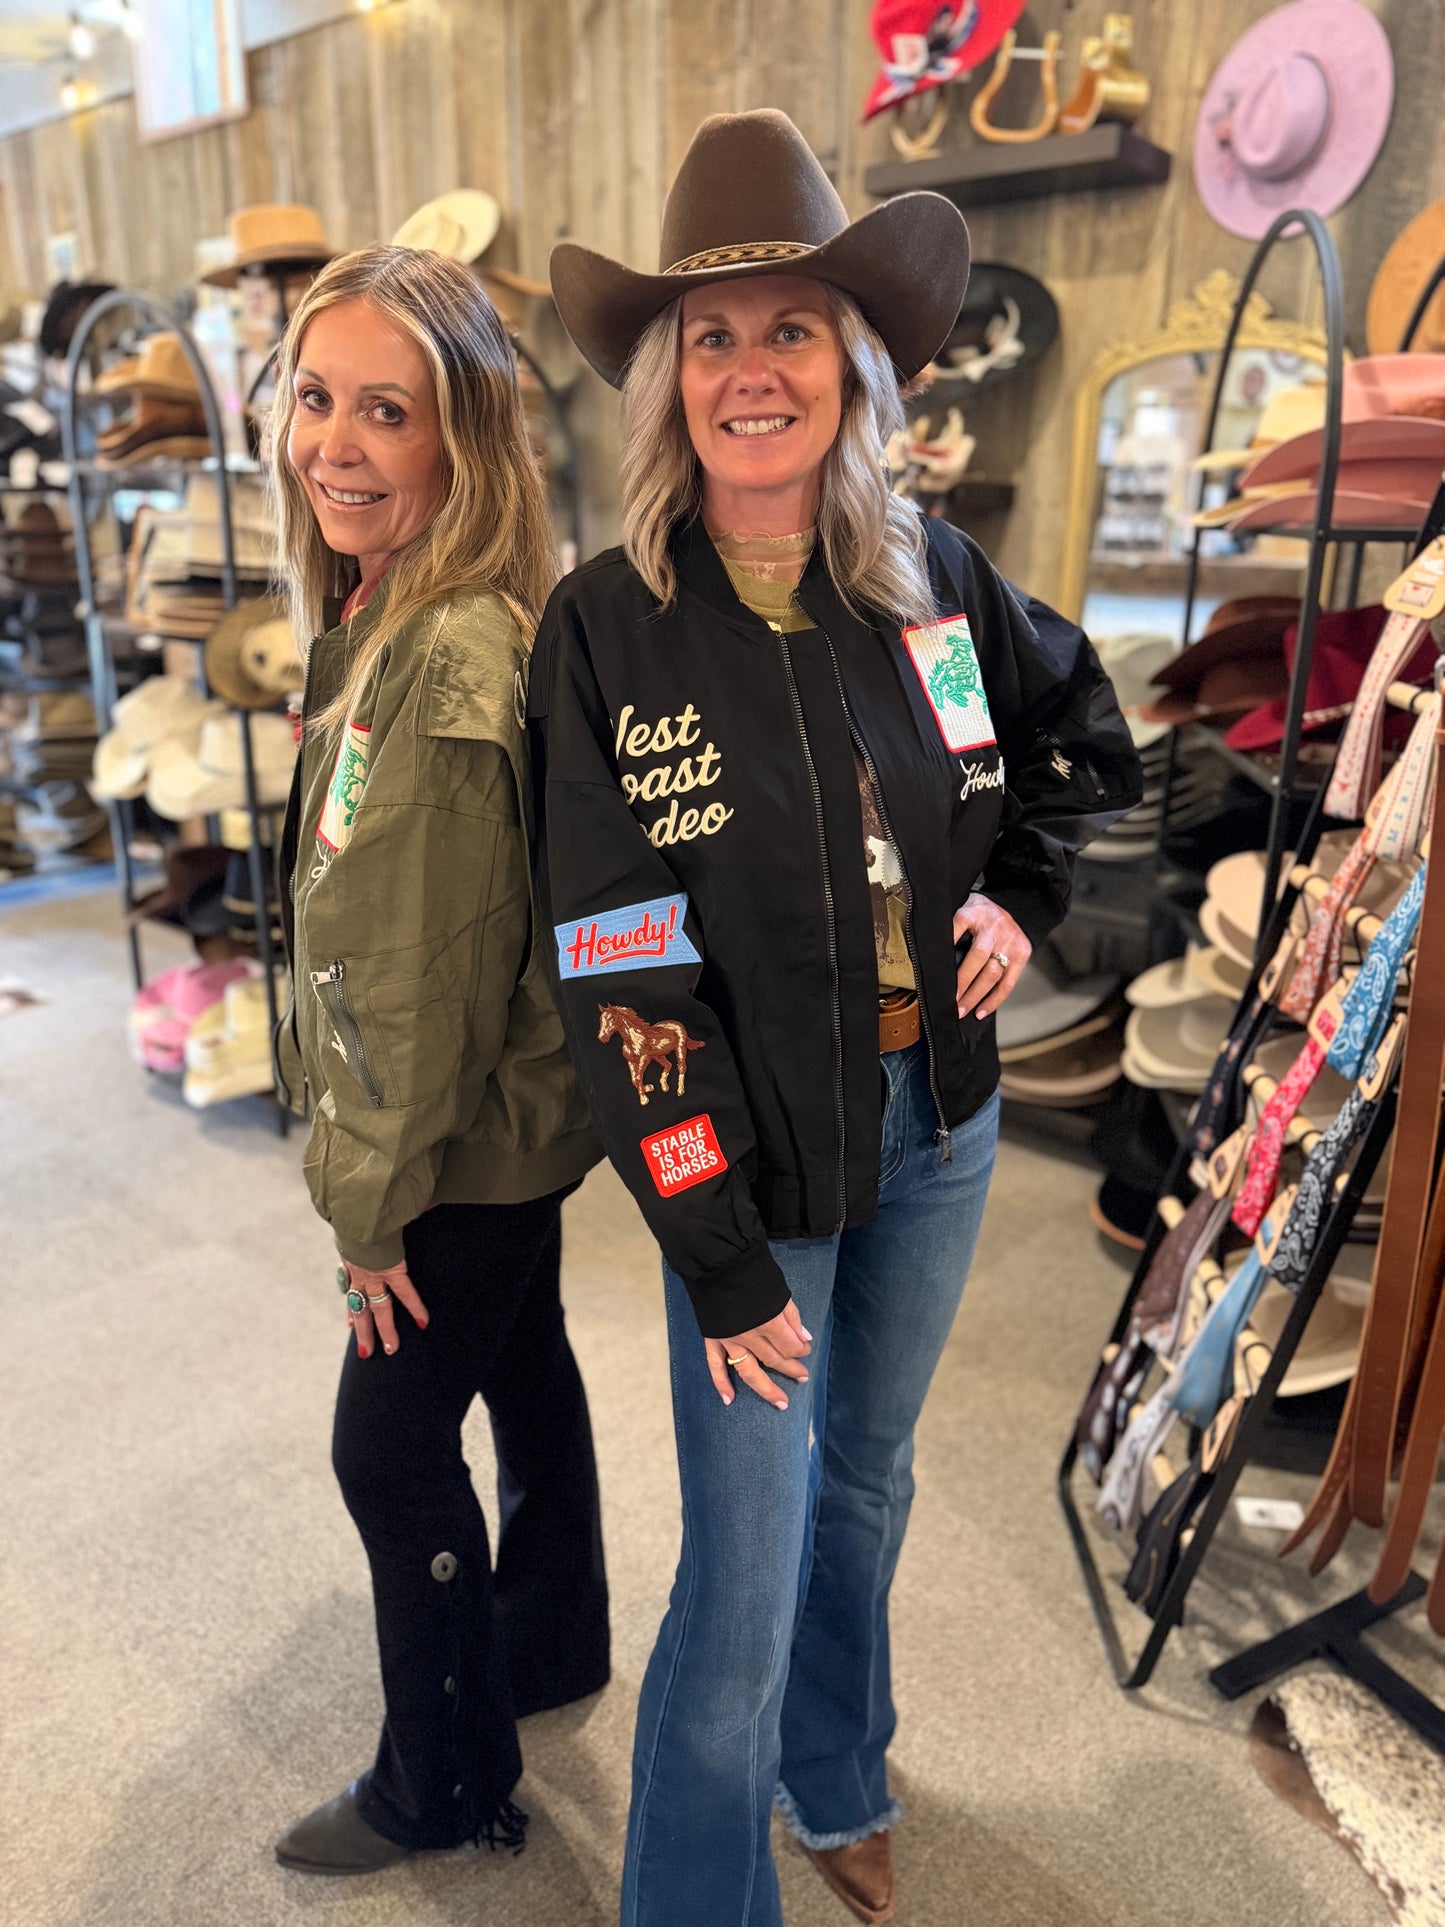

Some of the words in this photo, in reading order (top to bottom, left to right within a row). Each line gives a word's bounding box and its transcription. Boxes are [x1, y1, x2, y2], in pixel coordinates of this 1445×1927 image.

[621, 742, 722, 805] oast
[639, 799, 735, 848] deo
[566, 904, 678, 970] Howdy!
[650, 1122, 706, 1158] STABLE
[659, 1152, 675, 1171] IS
[678, 1139, 707, 1163] FOR
[661, 1150, 718, 1187] HORSES
